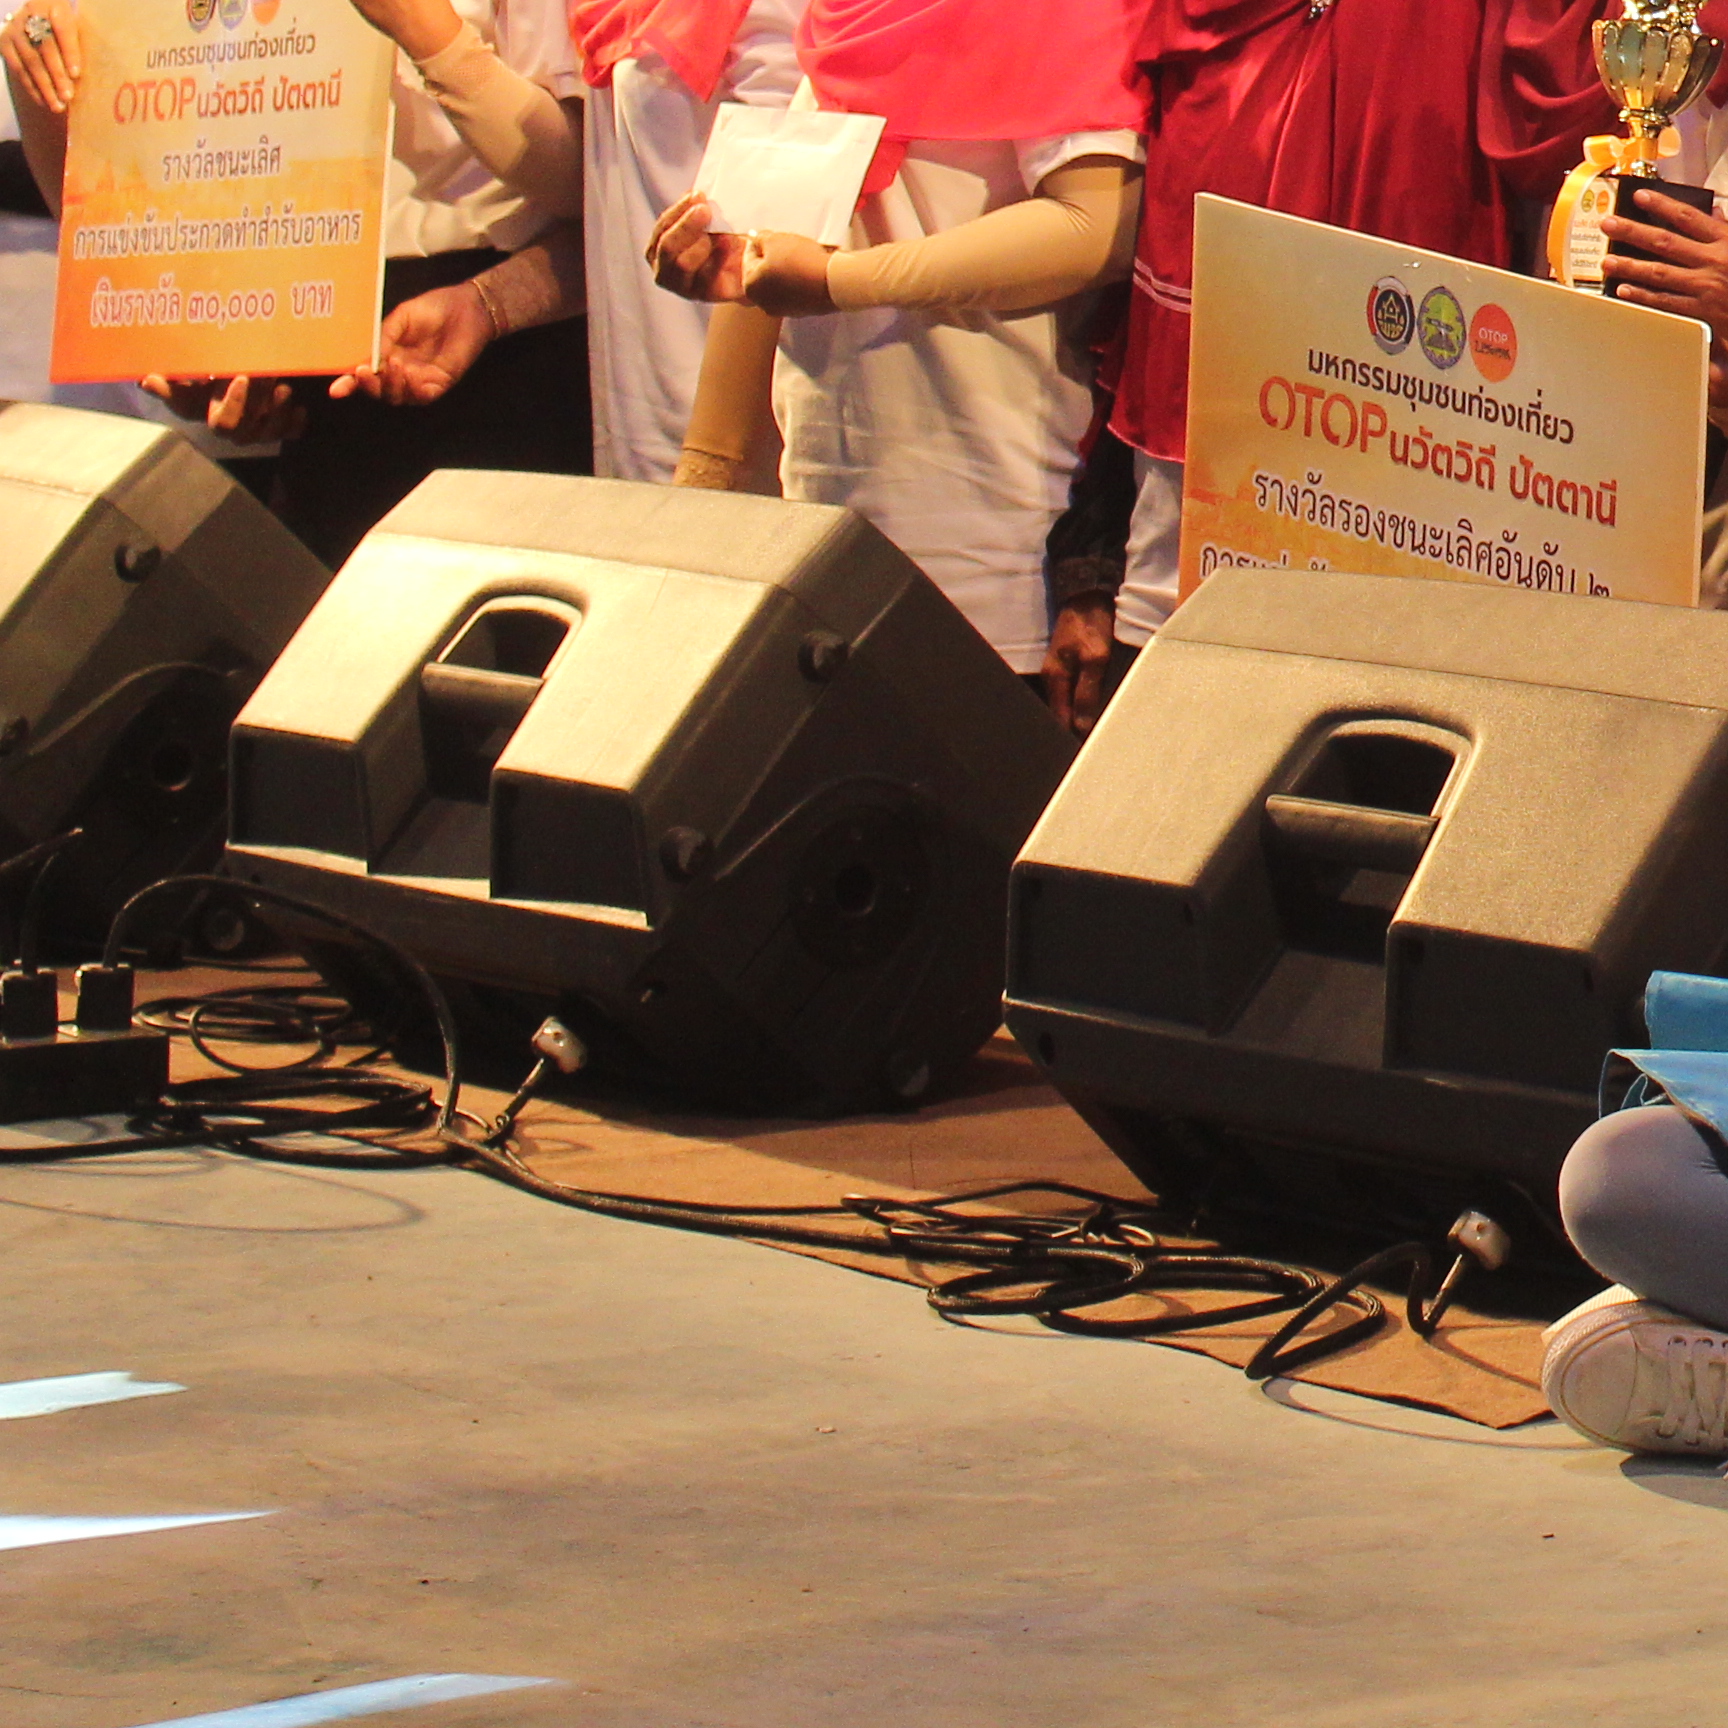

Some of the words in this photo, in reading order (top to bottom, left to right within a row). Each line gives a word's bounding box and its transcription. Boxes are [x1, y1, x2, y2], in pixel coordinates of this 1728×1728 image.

[146, 17, 316, 72] มหกรรมชุมชนท่องเที่ยว
[272, 69, 342, 112] ปัตตานี
[162, 134, 282, 183] รางวัลชนะเลิศ
[291, 281, 334, 318] บาท
[1307, 347, 1575, 445] มหกรรมชุมชนท่องเที่ยว
[1508, 454, 1619, 528] ปัตตานี
